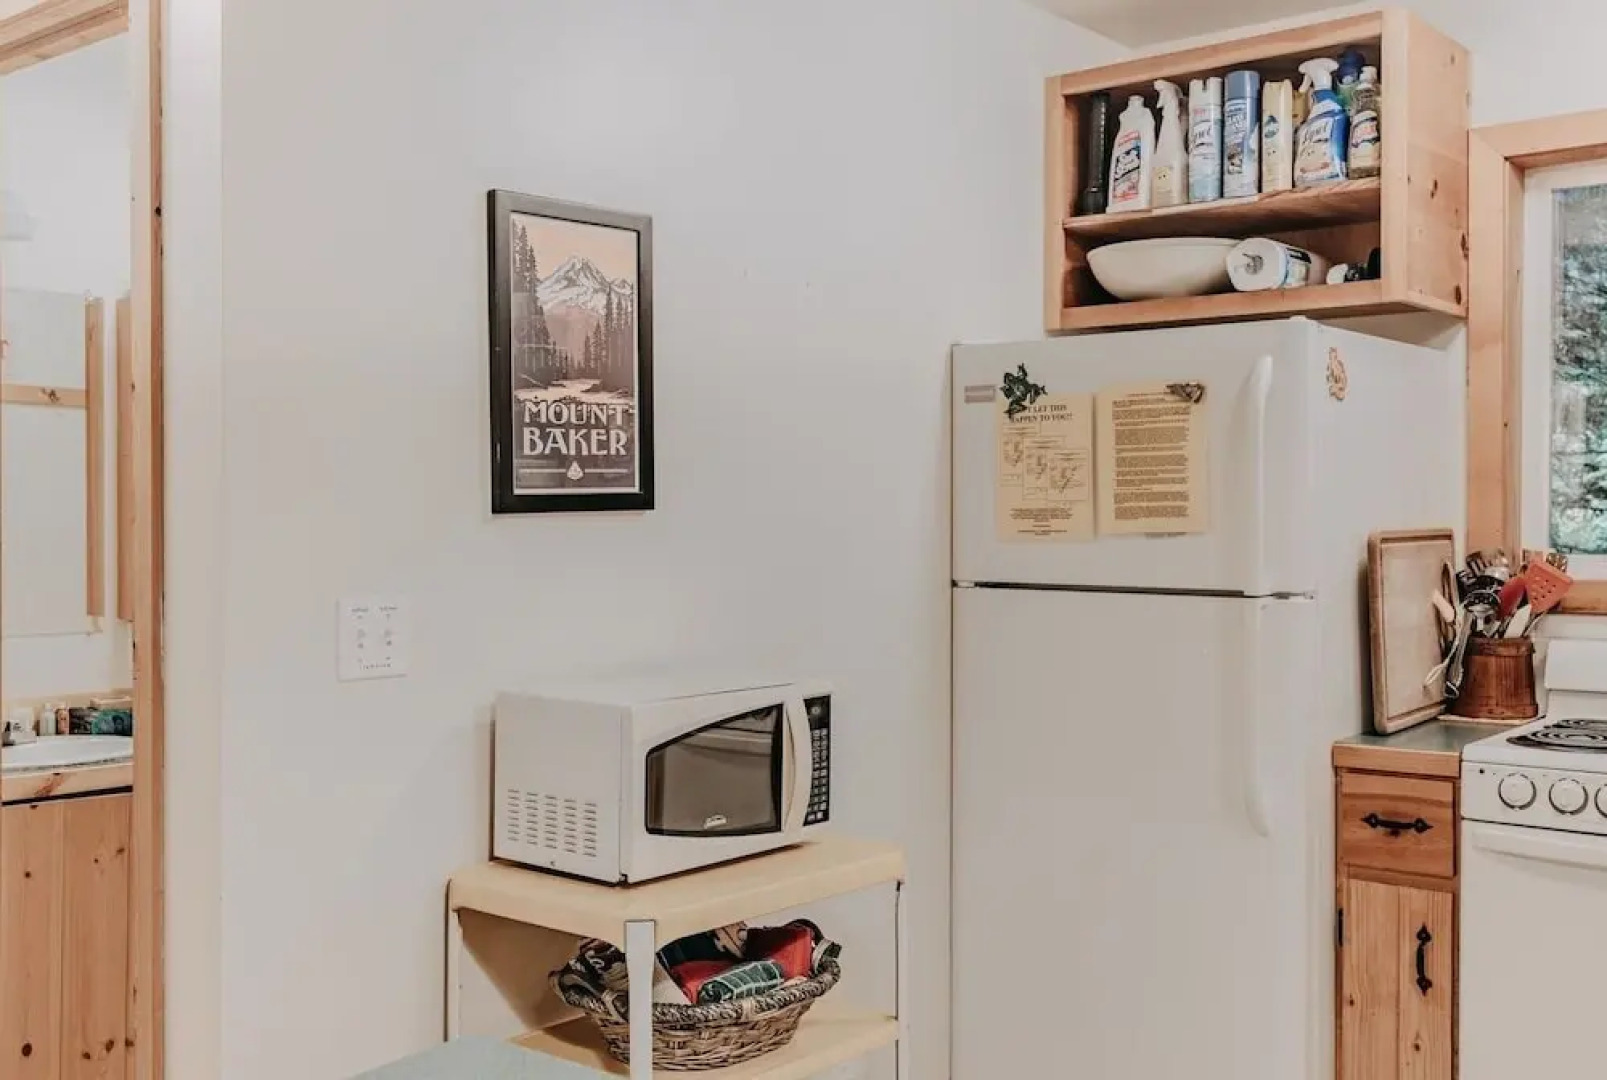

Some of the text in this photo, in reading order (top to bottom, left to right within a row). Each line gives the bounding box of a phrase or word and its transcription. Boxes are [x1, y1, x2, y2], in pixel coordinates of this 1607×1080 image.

[523, 401, 629, 427] MOUNT
[1040, 414, 1051, 422] TO
[523, 426, 628, 456] BAKER
